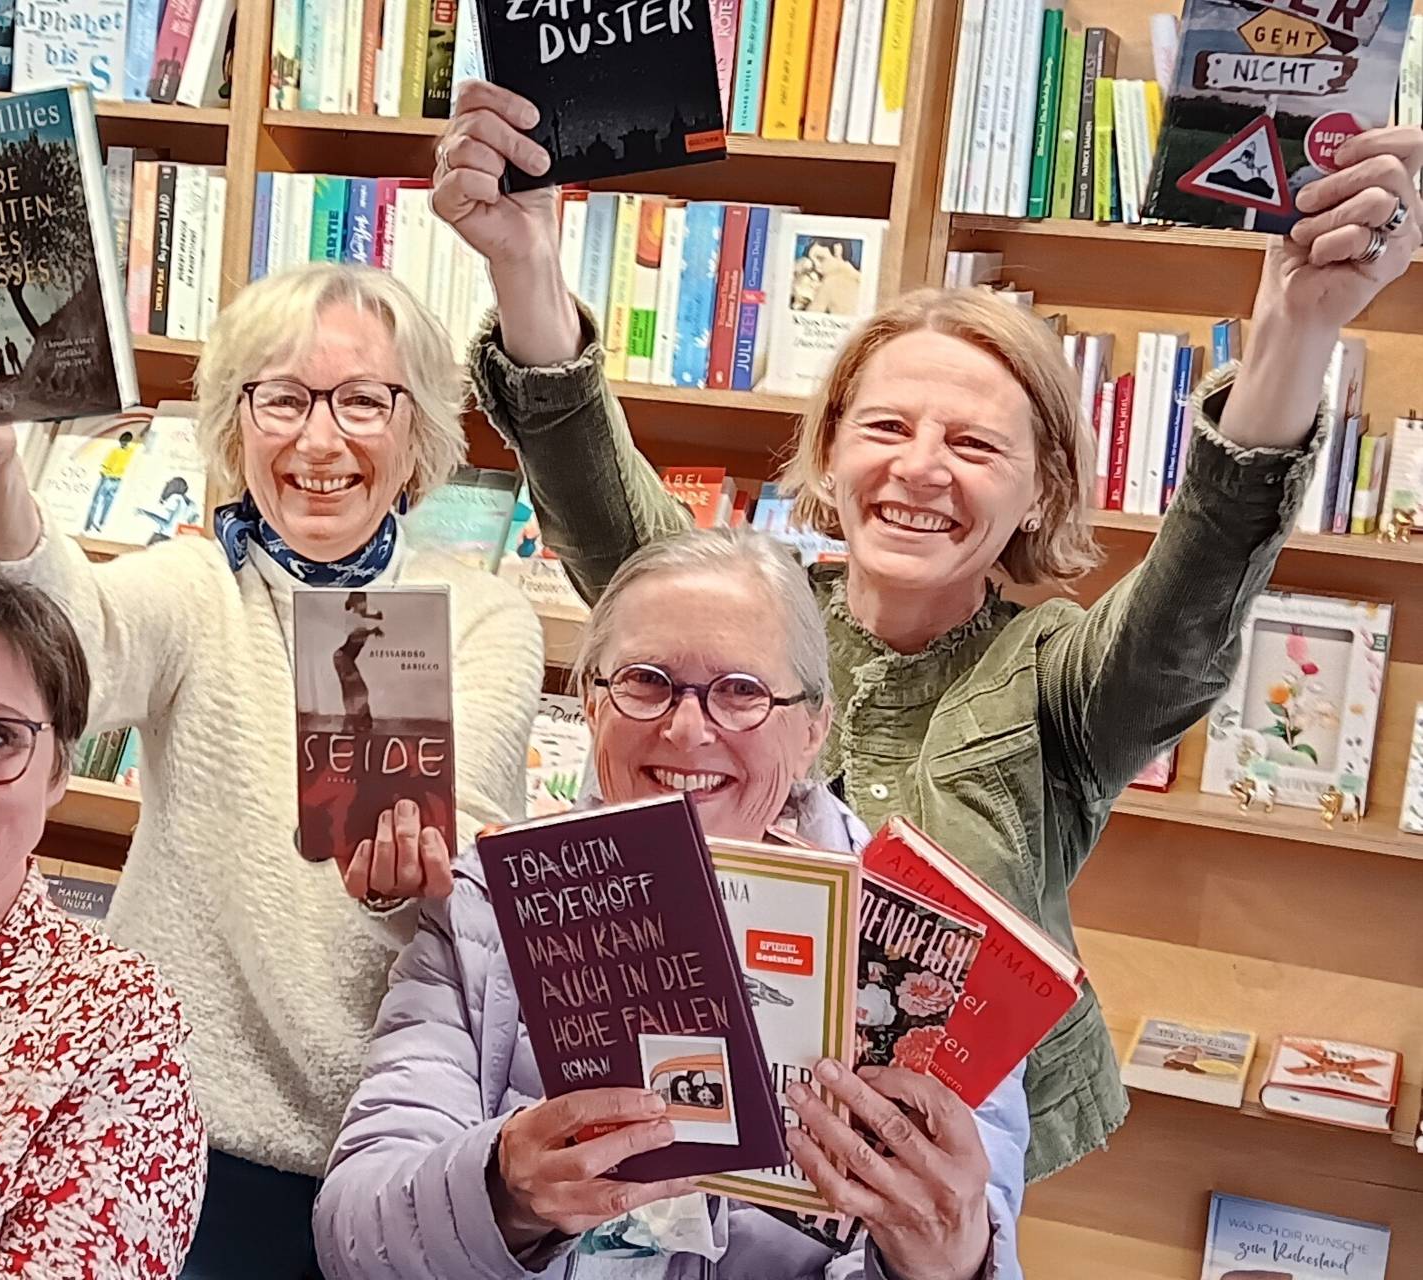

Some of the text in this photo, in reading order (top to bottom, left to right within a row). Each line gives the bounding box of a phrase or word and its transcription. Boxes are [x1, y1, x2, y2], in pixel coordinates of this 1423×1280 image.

[540, 0, 694, 64] DUSTER
[1254, 26, 1317, 49] GEHT
[45, 43, 77, 65] bis
[1233, 58, 1316, 85] NICHT
[326, 210, 339, 261] ARTIE
[740, 305, 756, 336] ZEH
[735, 338, 751, 371] JULI
[304, 733, 446, 777] SEIDE
[503, 836, 625, 888] JOACHIM
[57, 886, 105, 905] MANUELA
[63, 898, 93, 911] INUSA
[514, 872, 655, 928] MEYERHOFF
[525, 911, 666, 969] MAN KANN
[759, 939, 800, 954] SPIEGEL
[755, 951, 804, 966] Bestseller
[541, 951, 705, 1009] AUCH IN DIE
[549, 996, 731, 1053] HÖHE FALLEN
[561, 1055, 611, 1083] ROMAN
[1228, 1217, 1255, 1232] WAS
[1258, 1221, 1279, 1236] ICH
[1281, 1227, 1303, 1242] DIR
[1234, 1239, 1355, 1275] zum Ruhestand
